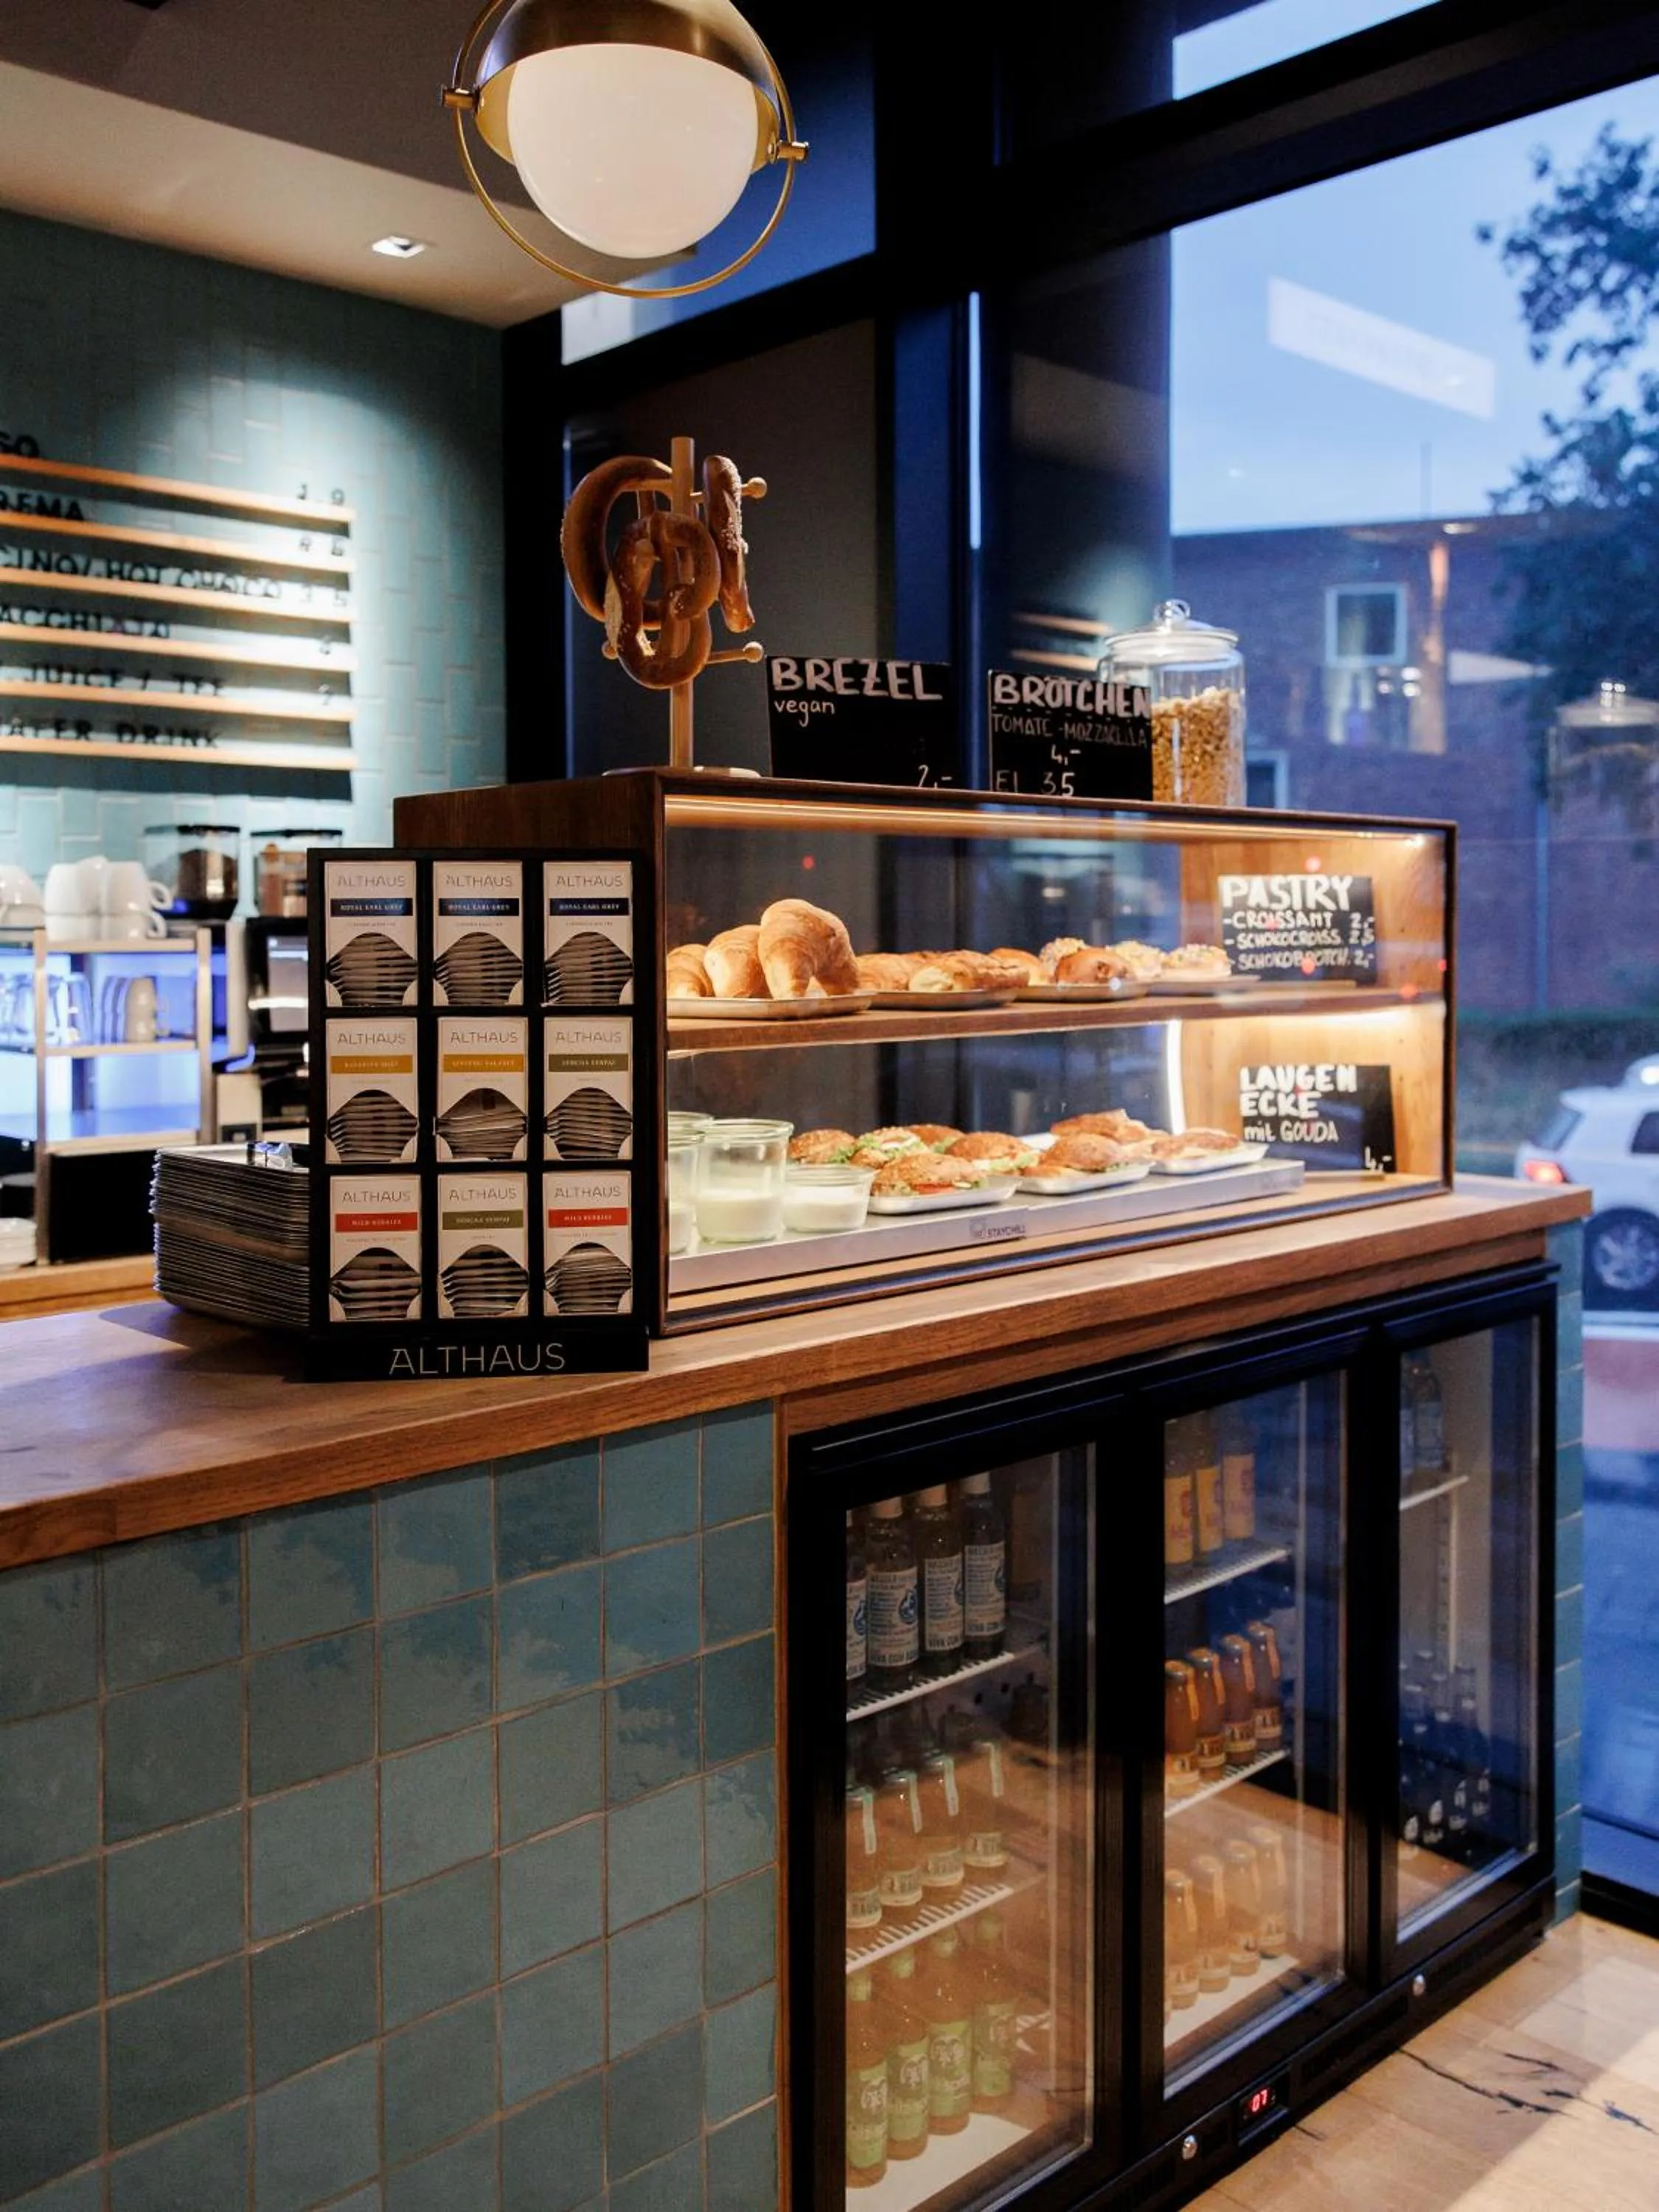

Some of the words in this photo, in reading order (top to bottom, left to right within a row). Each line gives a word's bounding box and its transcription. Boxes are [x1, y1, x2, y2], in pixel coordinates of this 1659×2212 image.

[771, 658, 943, 700] BREZEL
[774, 700, 835, 727] vegan
[992, 714, 1053, 737] TOMATE
[337, 874, 406, 887] ALTHAUS
[445, 874, 514, 888] ALTHAUS
[556, 874, 625, 887] ALTHAUS
[1223, 875, 1353, 911] PASTRY
[337, 1032, 406, 1046] ALTHAUS
[451, 1032, 518, 1044] ALTHAUS
[554, 1032, 622, 1044] ALTHAUS
[1240, 1065, 1357, 1093] LAUGEN
[1240, 1091, 1321, 1119] ECKE
[1244, 1120, 1276, 1142] mit
[1280, 1120, 1339, 1142] GOUDA
[342, 1190, 411, 1203] ALTHAUS
[448, 1188, 518, 1201] ALTHAUS
[554, 1186, 622, 1199] ALTHAUS
[389, 1343, 566, 1374] ALTHAUS
